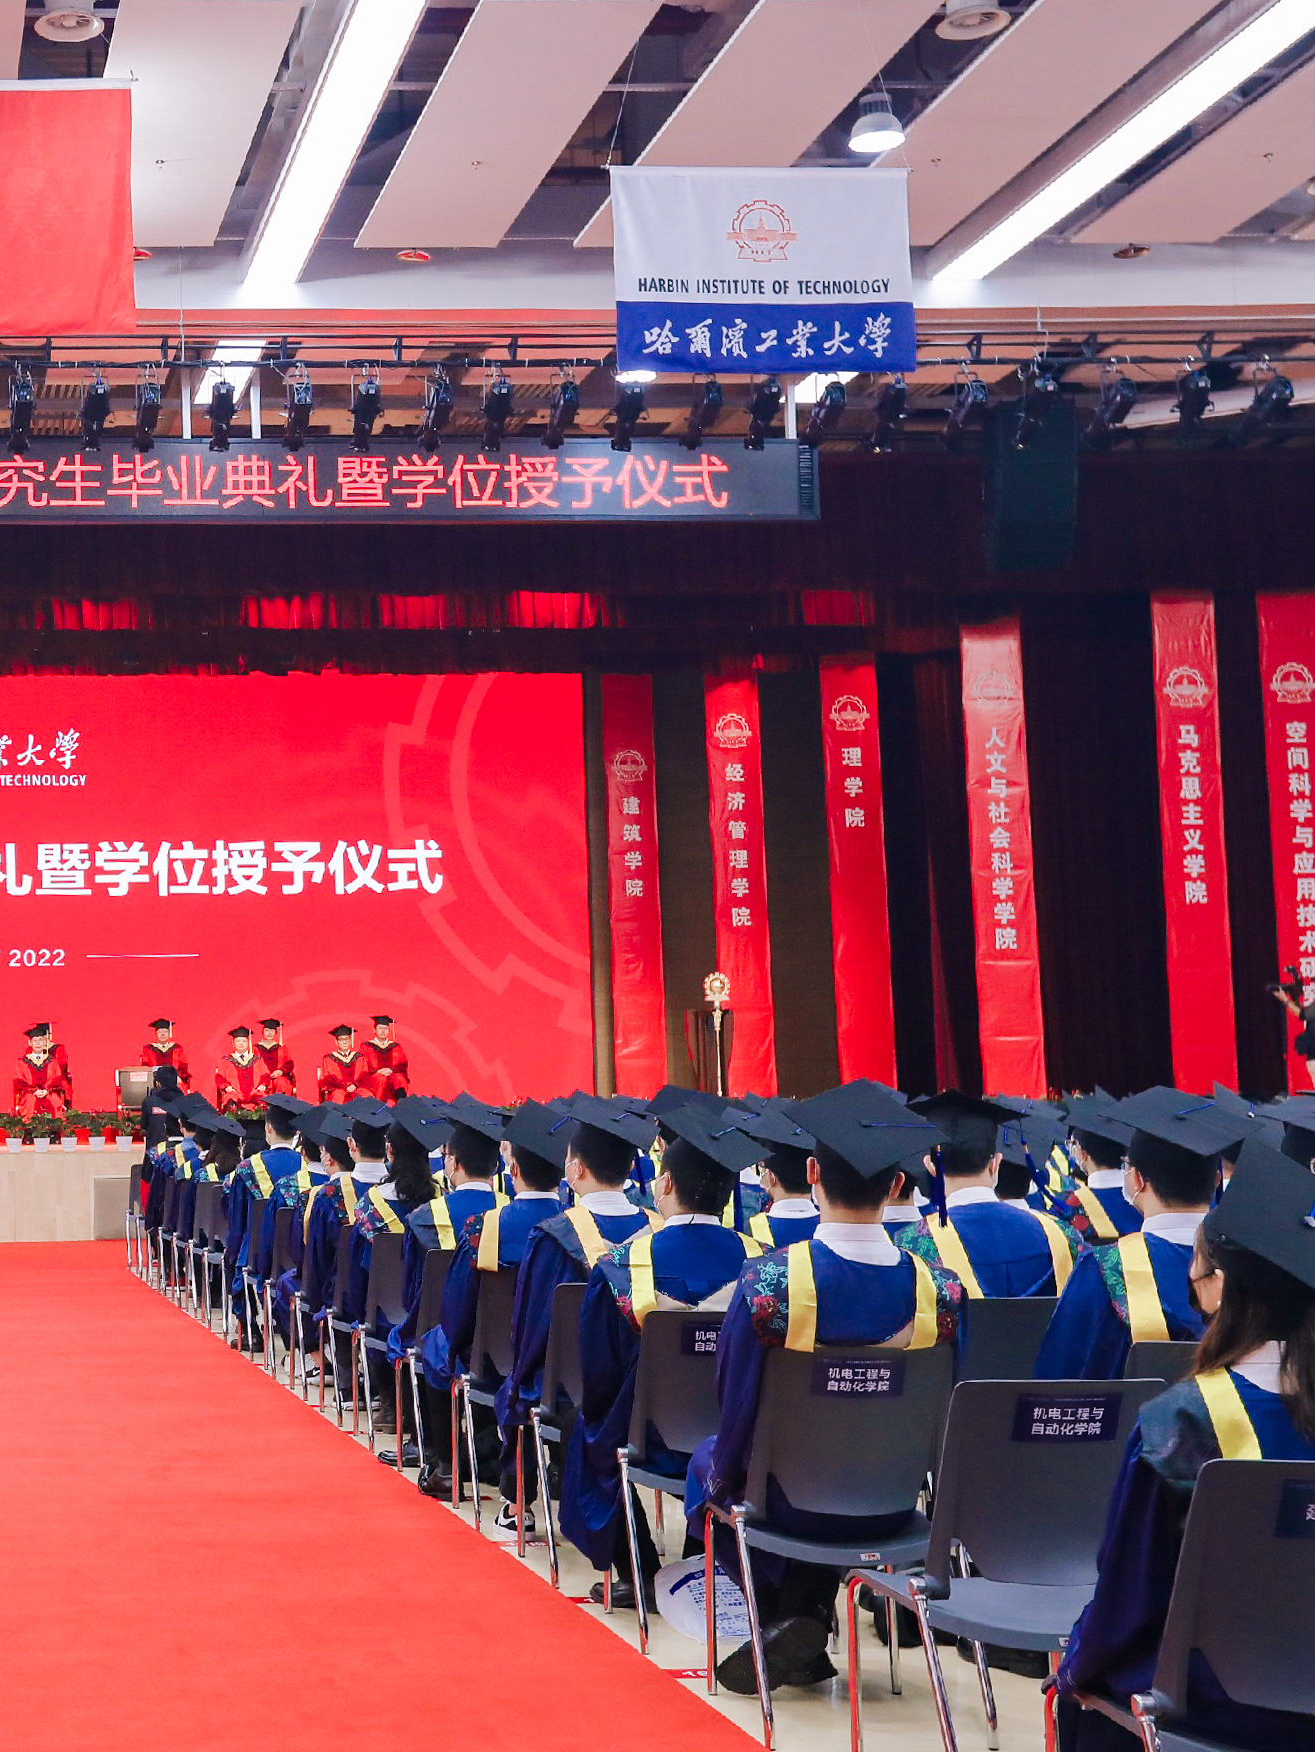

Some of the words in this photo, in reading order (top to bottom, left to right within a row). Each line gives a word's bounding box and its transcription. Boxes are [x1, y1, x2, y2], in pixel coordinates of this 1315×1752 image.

[638, 277, 689, 293] HARBIN
[697, 279, 766, 295] INSTITUTE
[772, 280, 789, 295] OF
[798, 279, 890, 294] TECHNOLOGY
[0, 774, 87, 787] TECHNOLOGY
[841, 747, 865, 829] 理学院
[1177, 725, 1208, 904] 马克思主义学院
[622, 796, 643, 898] 建筑学院
[725, 762, 752, 927] 经济管理学院
[985, 727, 1017, 950] 人文与社会科学学院
[8, 948, 65, 967] 2022
[695, 1331, 721, 1341] 机电
[828, 1368, 891, 1380] 机电工程与
[827, 1380, 890, 1392] 自动化学院
[1033, 1407, 1105, 1421] 机电工程与
[1031, 1421, 1102, 1435] 自动化学院
